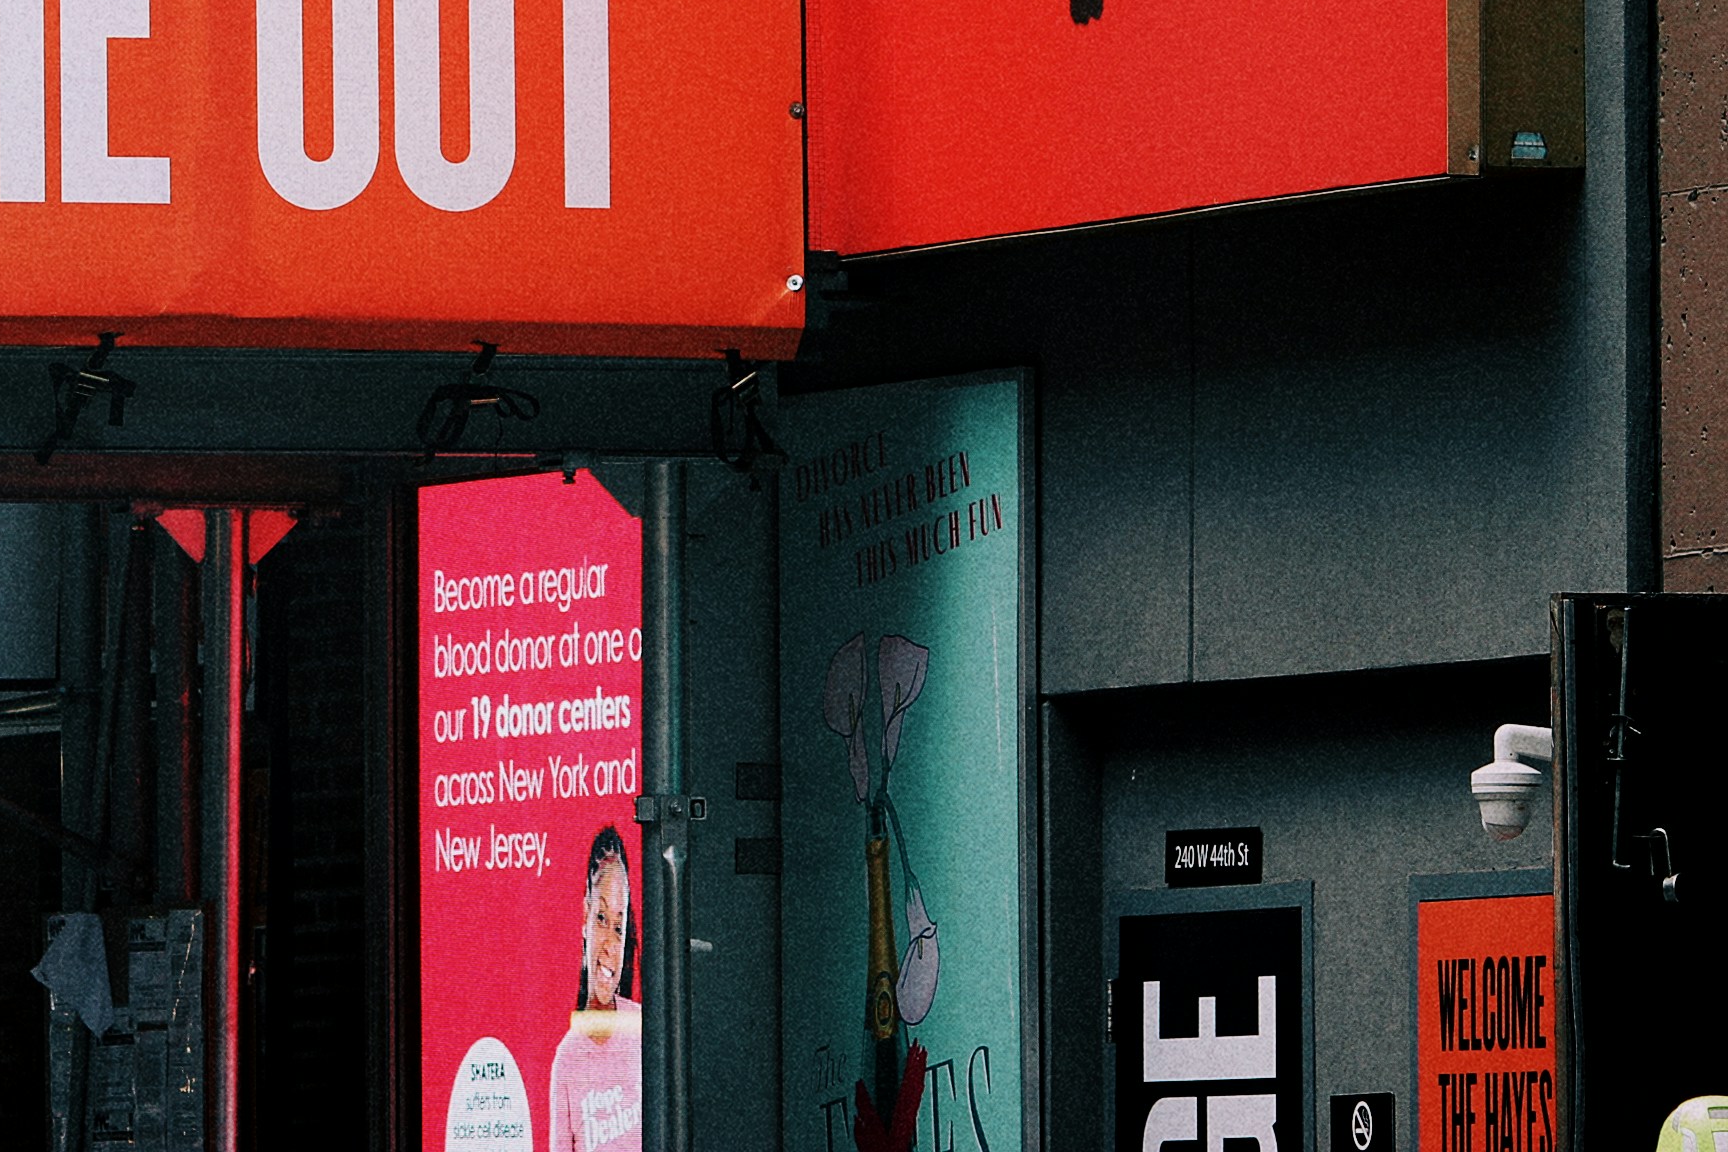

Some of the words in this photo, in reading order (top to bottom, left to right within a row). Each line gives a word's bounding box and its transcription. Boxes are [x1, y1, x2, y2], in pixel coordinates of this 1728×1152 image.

[925, 451, 970, 503] BEEN
[905, 510, 961, 567] MUCH
[968, 492, 1002, 541] FUN
[434, 570, 514, 613] Become
[520, 572, 534, 604] a
[538, 555, 608, 612] regular
[434, 628, 491, 678] blood
[495, 628, 555, 673] donor
[559, 621, 580, 668] at
[584, 628, 624, 666] one
[628, 627, 643, 662] o
[434, 709, 467, 743] our
[471, 695, 491, 739] 19
[495, 693, 554, 738] donor
[558, 685, 631, 733] centers
[434, 771, 494, 807] across
[499, 759, 544, 802] New
[548, 752, 590, 799] York
[594, 747, 636, 797] and
[435, 827, 481, 872] New
[485, 823, 551, 877] Jersey.
[1174, 845, 1195, 869] 240
[1196, 843, 1209, 868] W
[1209, 841, 1235, 867] 44th
[1237, 842, 1250, 866] St
[1438, 955, 1546, 1051] WELCOME
[1439, 1073, 1477, 1152] THE
[1485, 1069, 1553, 1152] HAYES
